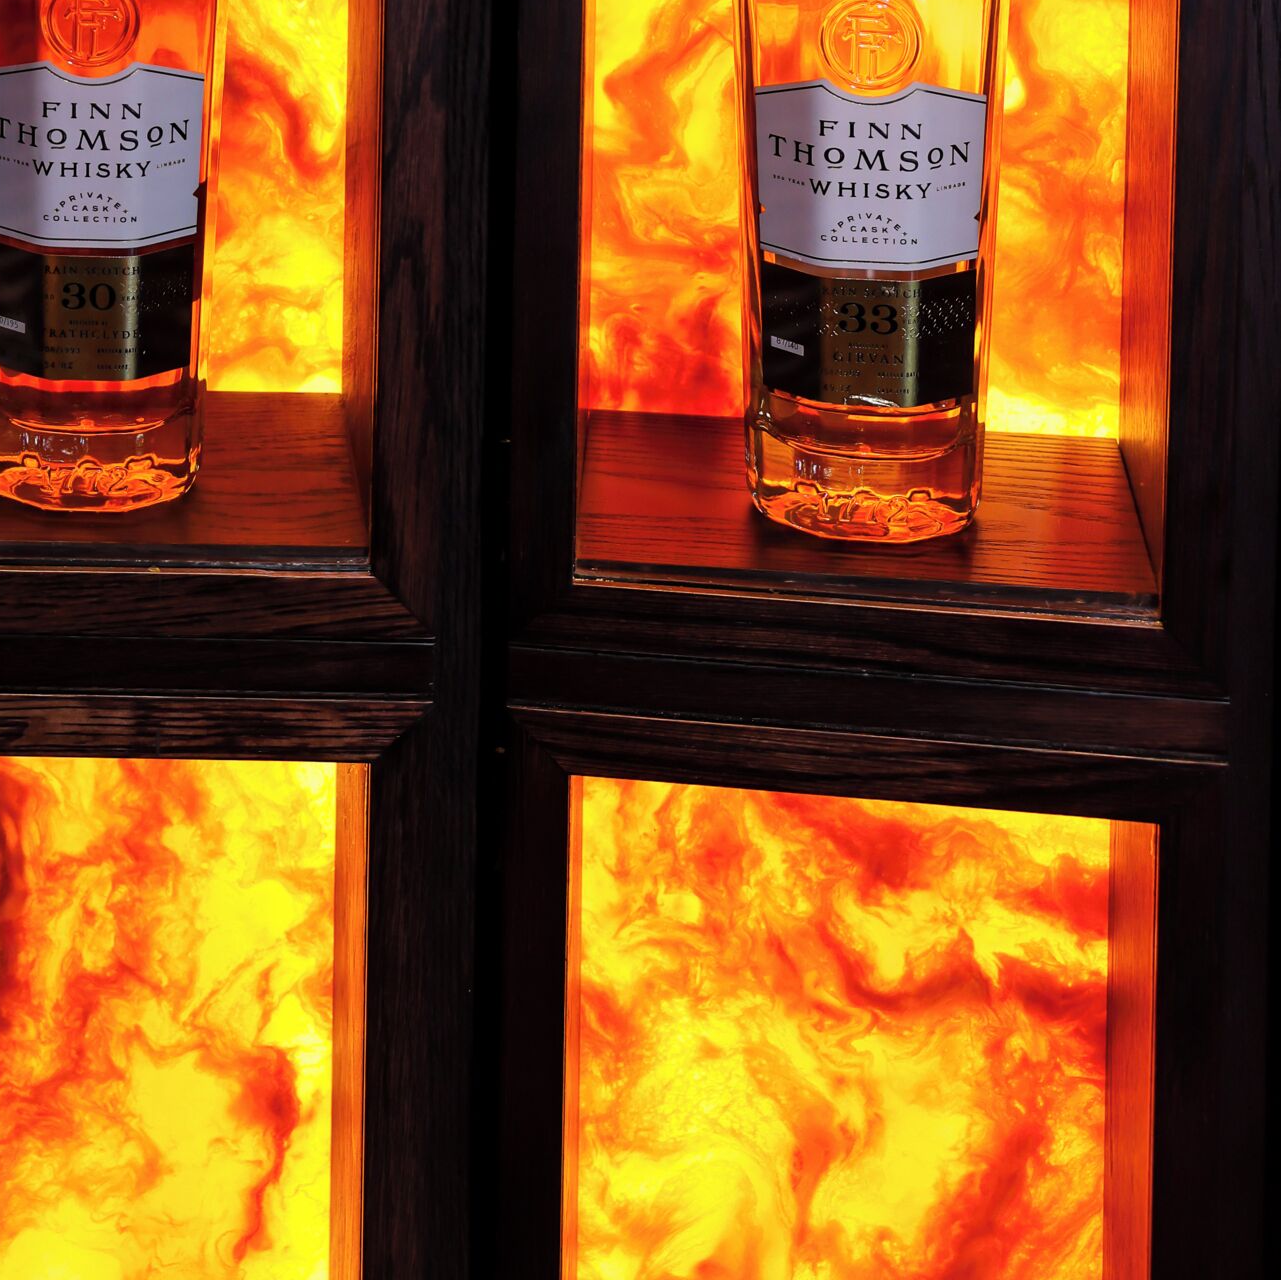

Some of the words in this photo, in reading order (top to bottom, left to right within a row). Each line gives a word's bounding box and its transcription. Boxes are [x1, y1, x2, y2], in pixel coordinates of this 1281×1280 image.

[42, 102, 143, 120] FINN
[819, 120, 922, 140] FINN
[769, 134, 970, 172] THOMSON
[32, 159, 151, 178] WHISKY
[809, 178, 932, 200] WHISKY
[59, 192, 122, 210] PRIVATE
[43, 214, 138, 223] COLLECTION
[837, 213, 901, 231] PRIVATE
[850, 226, 888, 234] CASK
[820, 234, 918, 245] COLLECTION
[62, 283, 116, 311] 30
[839, 303, 898, 335] 33
[833, 352, 905, 364] GIRVAN
